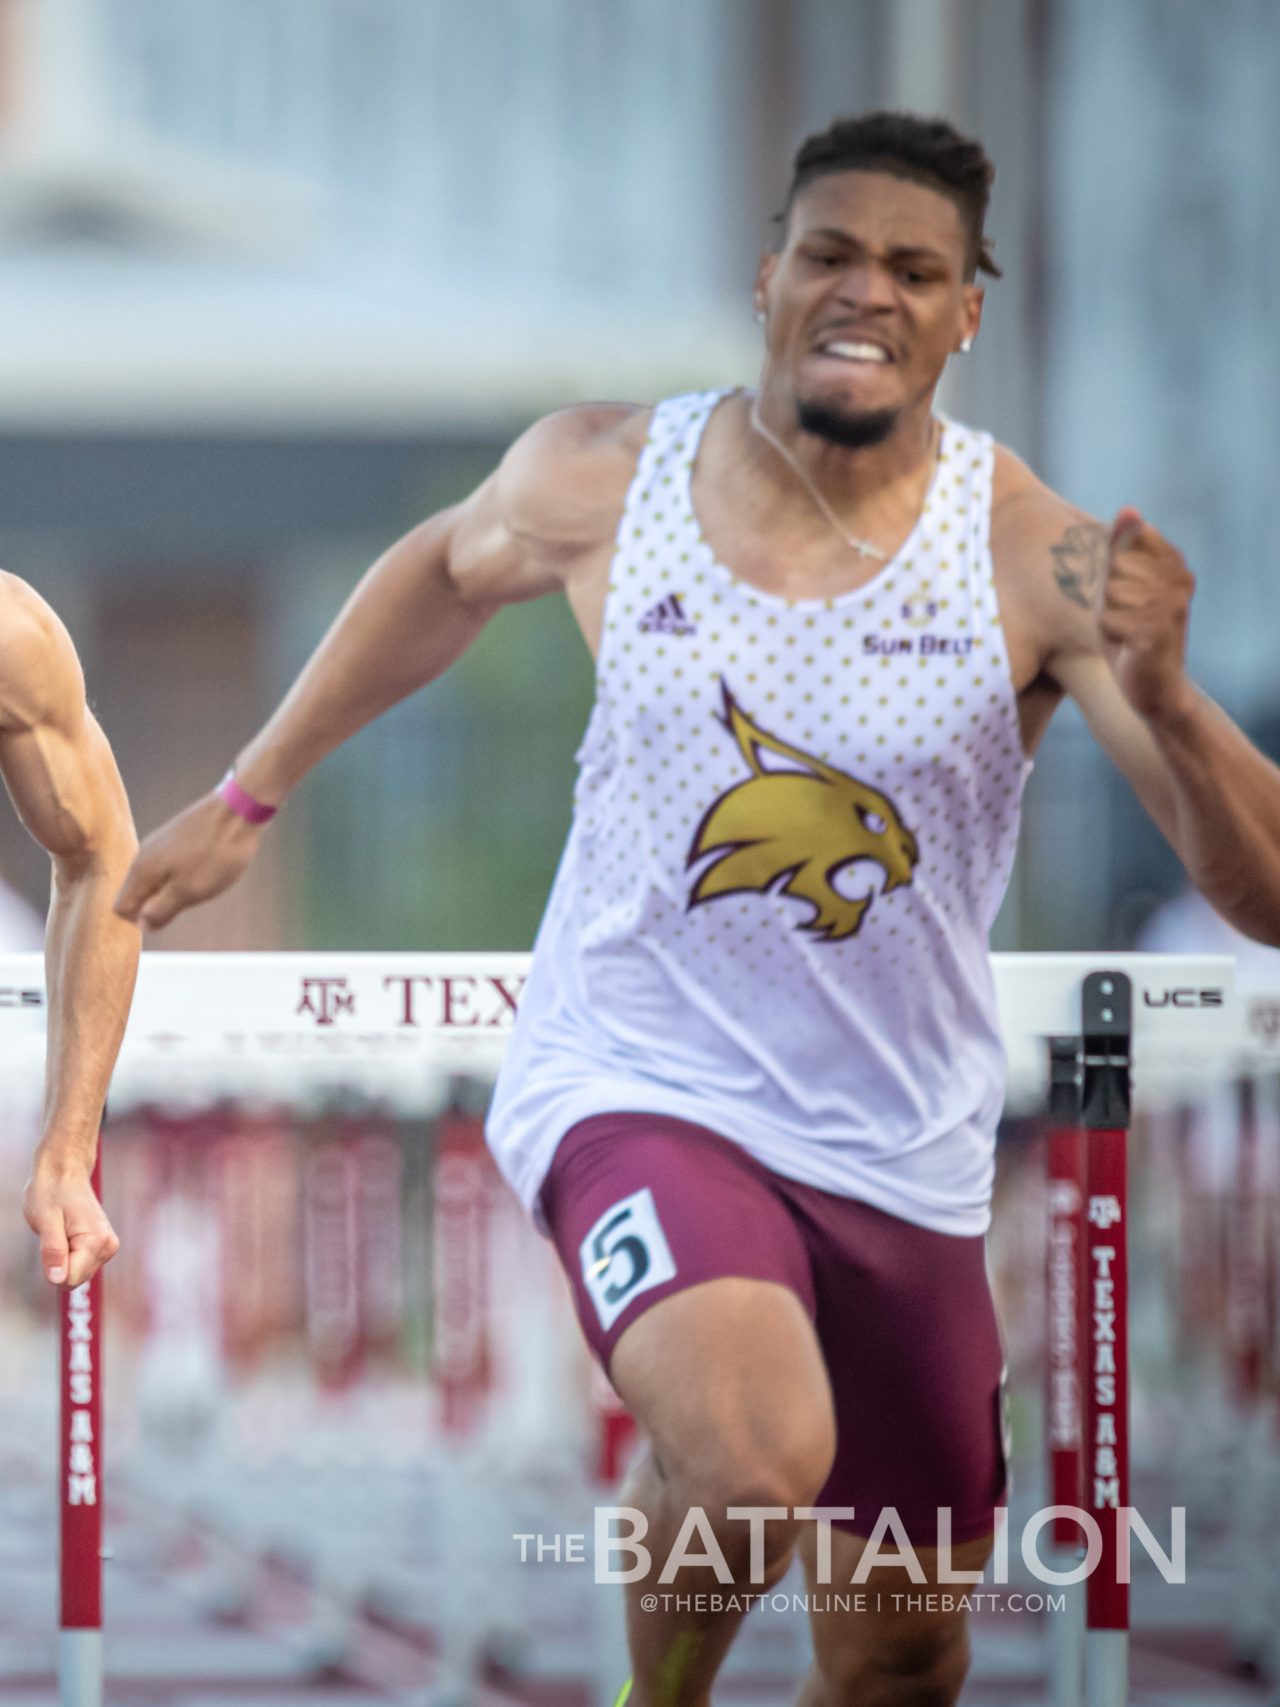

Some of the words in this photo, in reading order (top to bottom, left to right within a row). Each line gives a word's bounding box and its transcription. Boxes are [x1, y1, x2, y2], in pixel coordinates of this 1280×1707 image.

[382, 974, 528, 1027] TEX
[1143, 988, 1224, 1008] UCS
[593, 1207, 651, 1305] 5
[67, 1281, 93, 1404] EXAS
[1091, 1245, 1116, 1406] TEXAS
[1093, 1413, 1120, 1508] A&M
